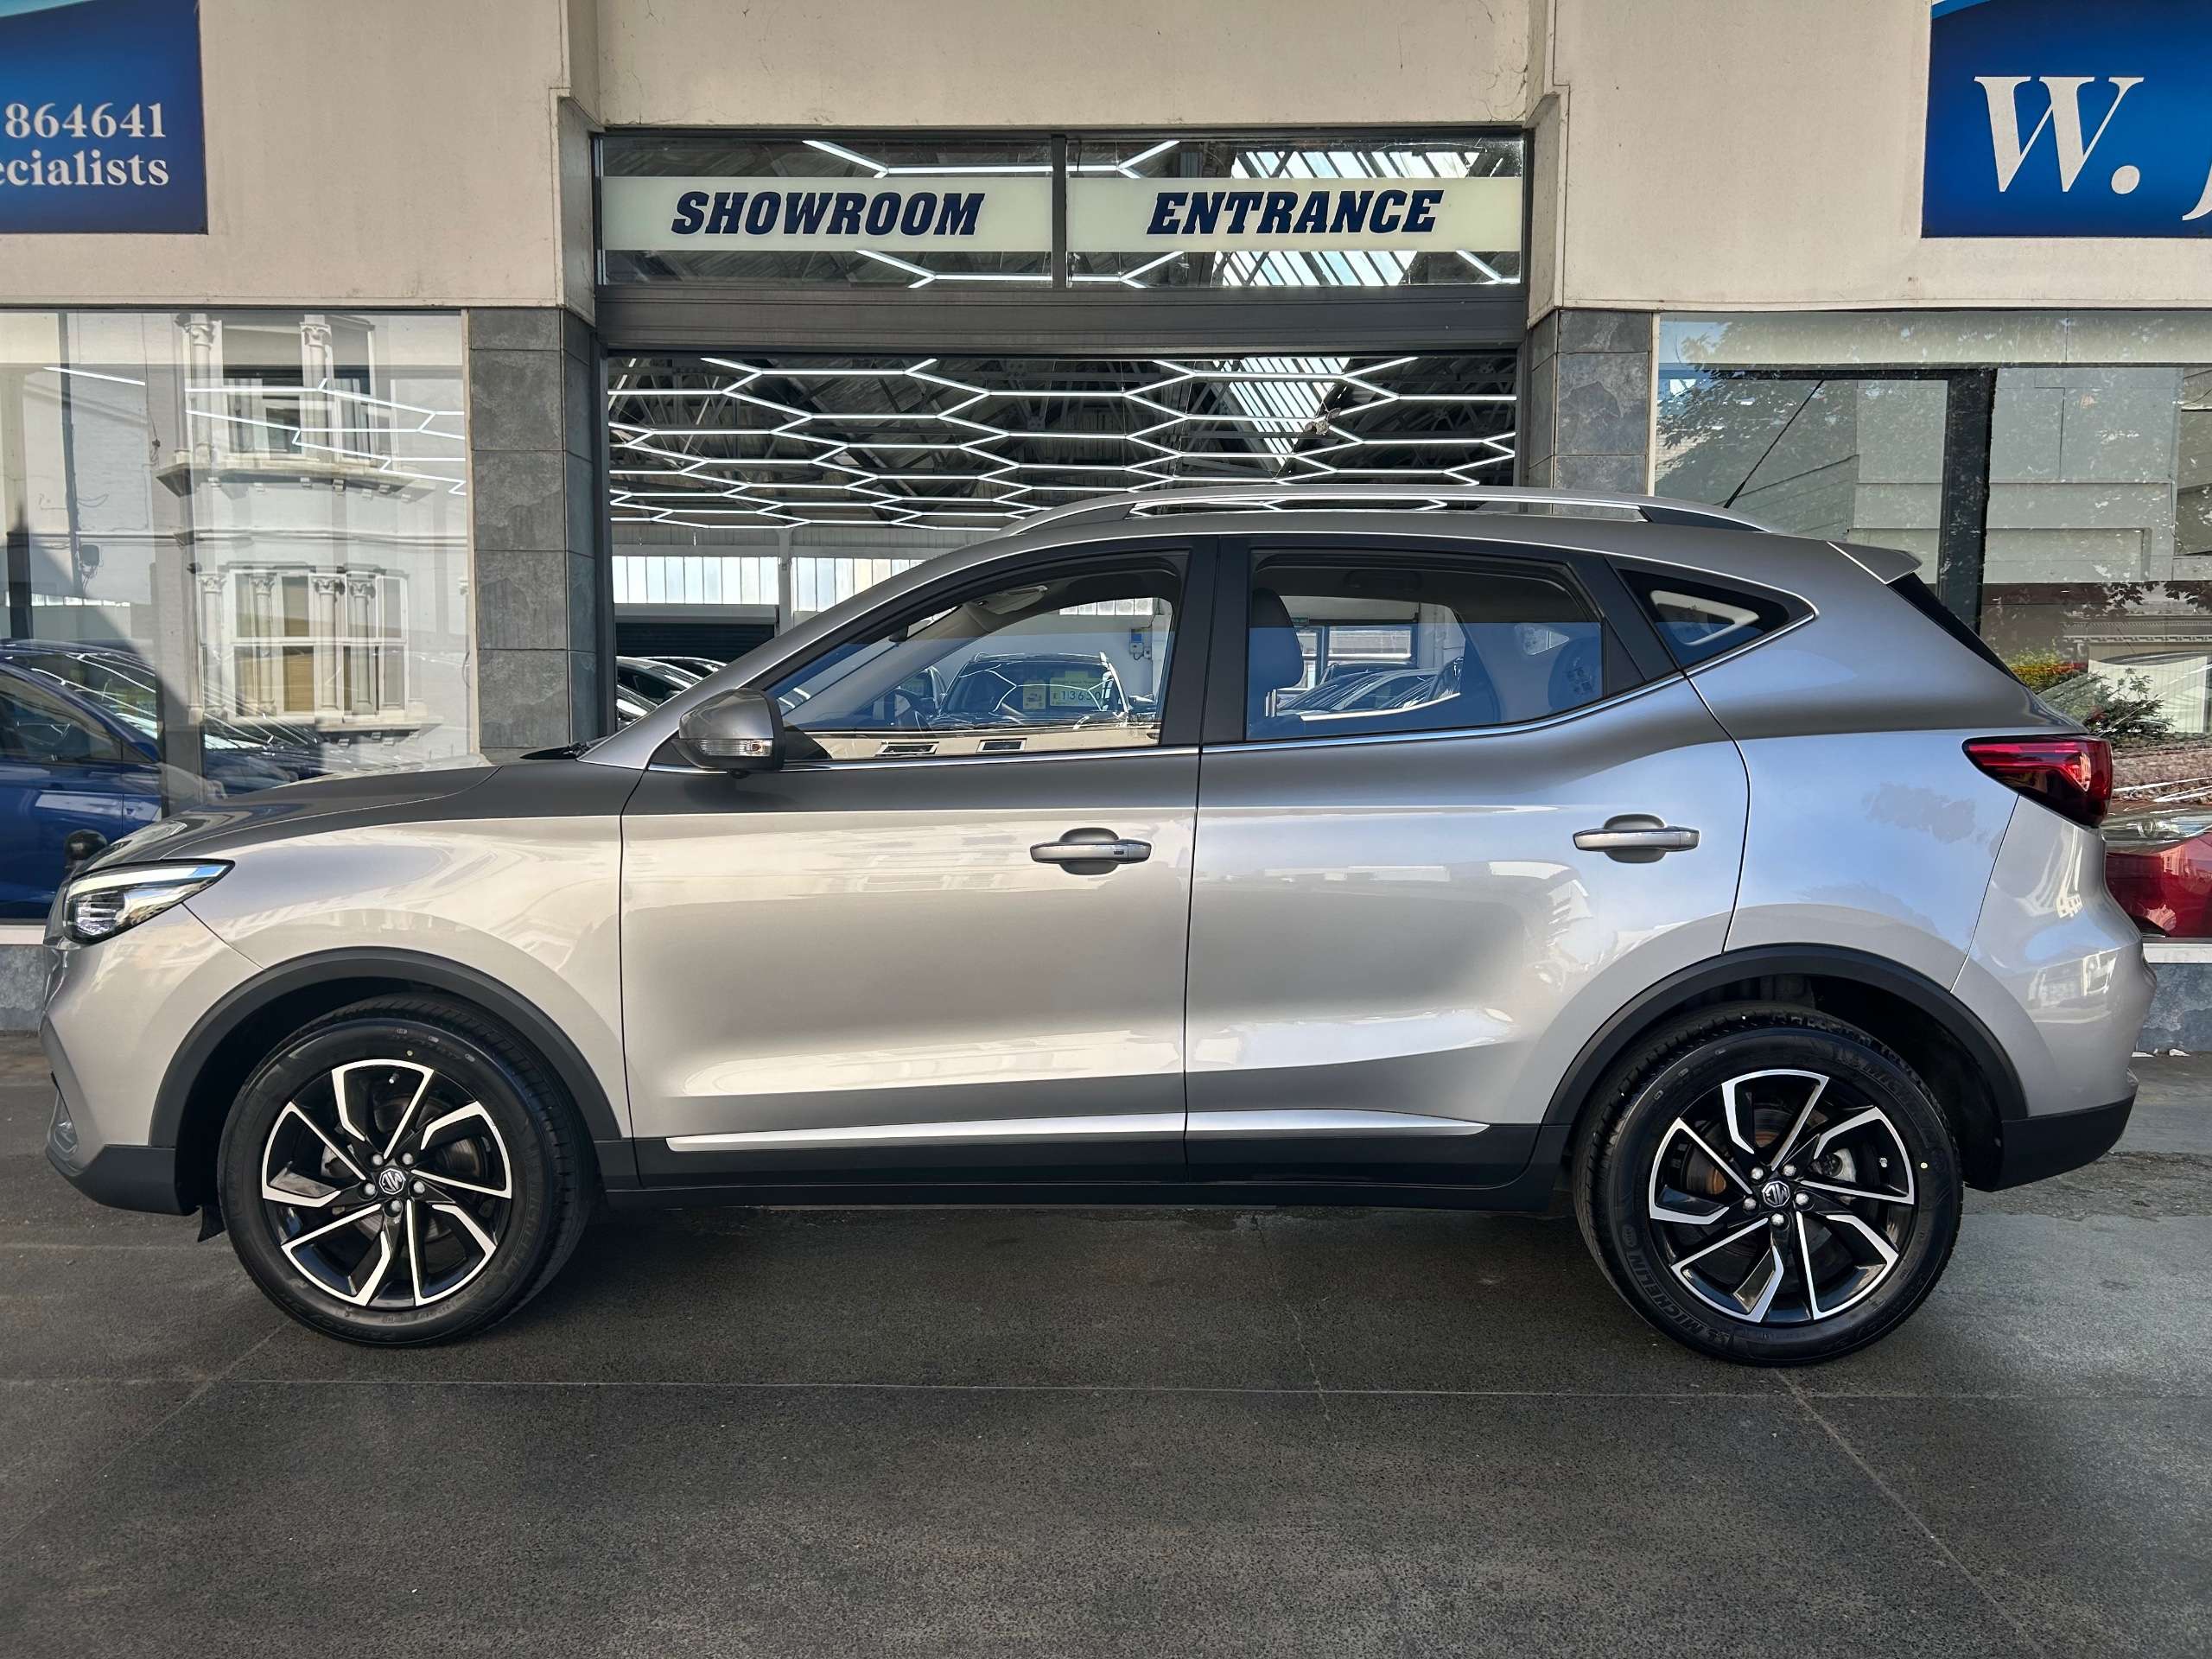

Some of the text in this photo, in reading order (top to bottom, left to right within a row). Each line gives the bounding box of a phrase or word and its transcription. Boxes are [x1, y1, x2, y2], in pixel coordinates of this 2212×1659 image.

[5, 102, 166, 138] 864641
[1974, 76, 2145, 194] W.
[0, 149, 169, 186] cialists
[671, 189, 1445, 236] SHOWROOM ENTRANCE
[1764, 1183, 1789, 1205] MG
[1627, 1252, 1702, 1335] MICHELIN
